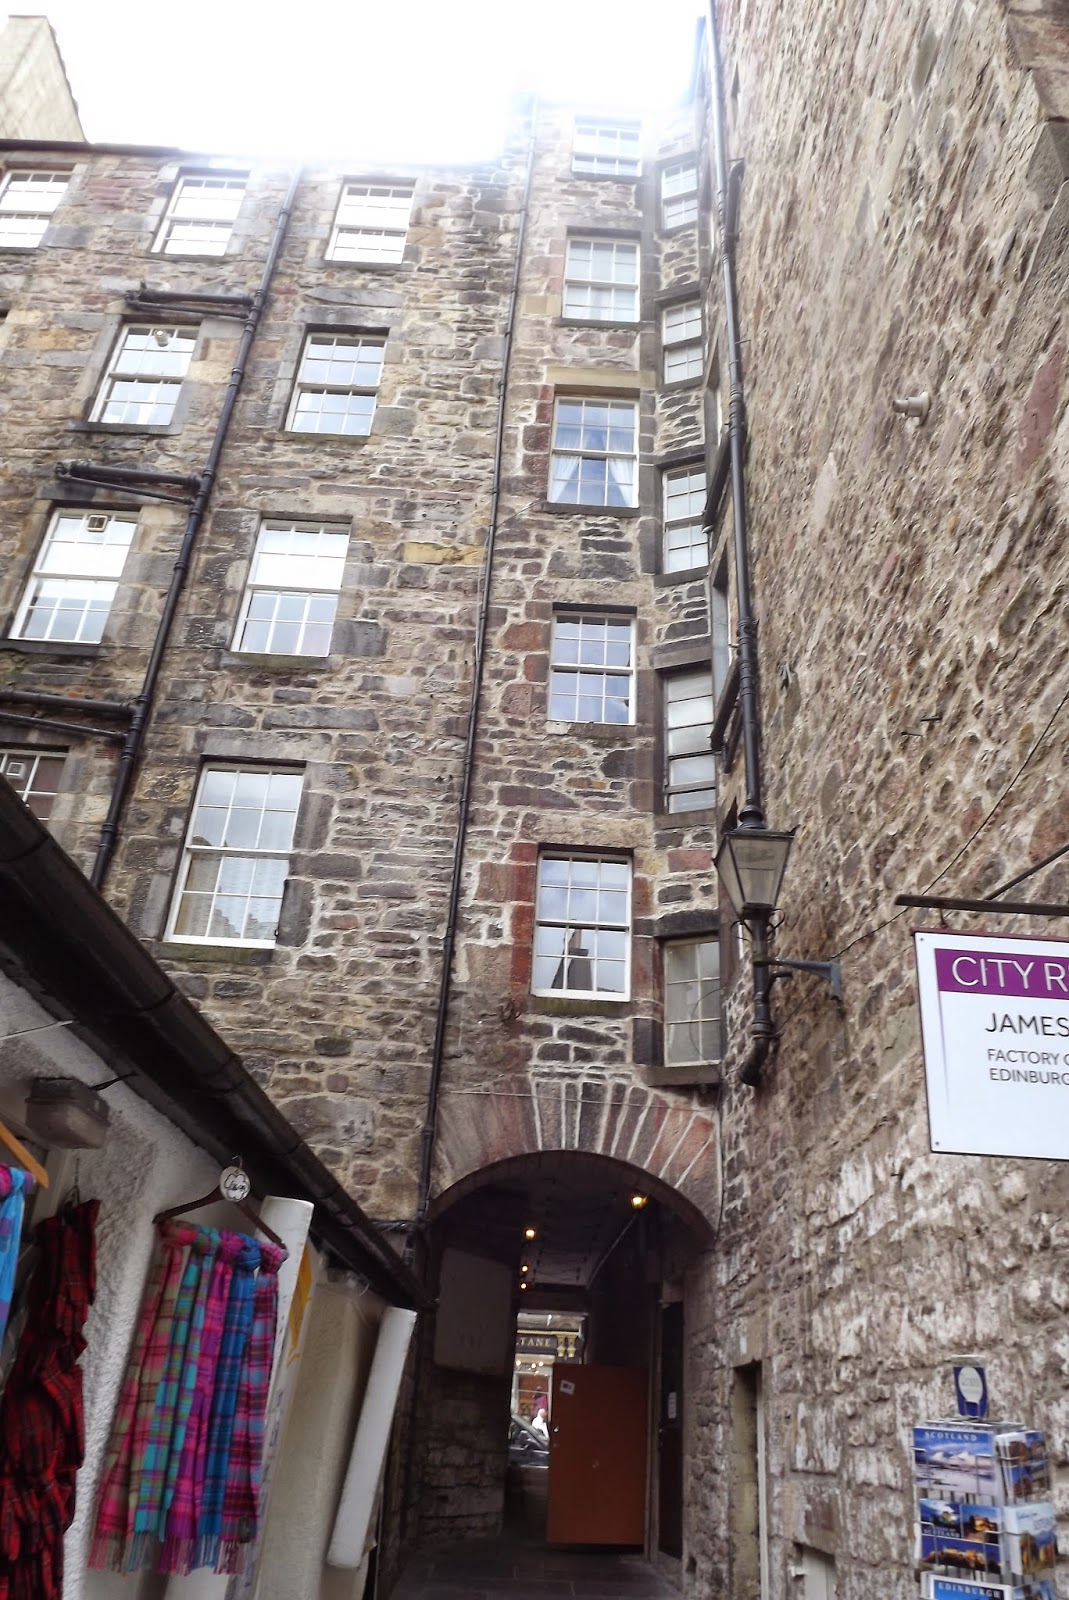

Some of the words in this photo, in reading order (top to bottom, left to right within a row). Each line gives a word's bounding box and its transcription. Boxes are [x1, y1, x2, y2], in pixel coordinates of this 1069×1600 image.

[952, 956, 1035, 989] CITY
[1043, 962, 1069, 993] R
[985, 1012, 1069, 1038] JAMES
[987, 1048, 1060, 1066] FACTORY
[515, 1337, 551, 1348] TANE
[924, 1431, 977, 1442] SCOTLAND
